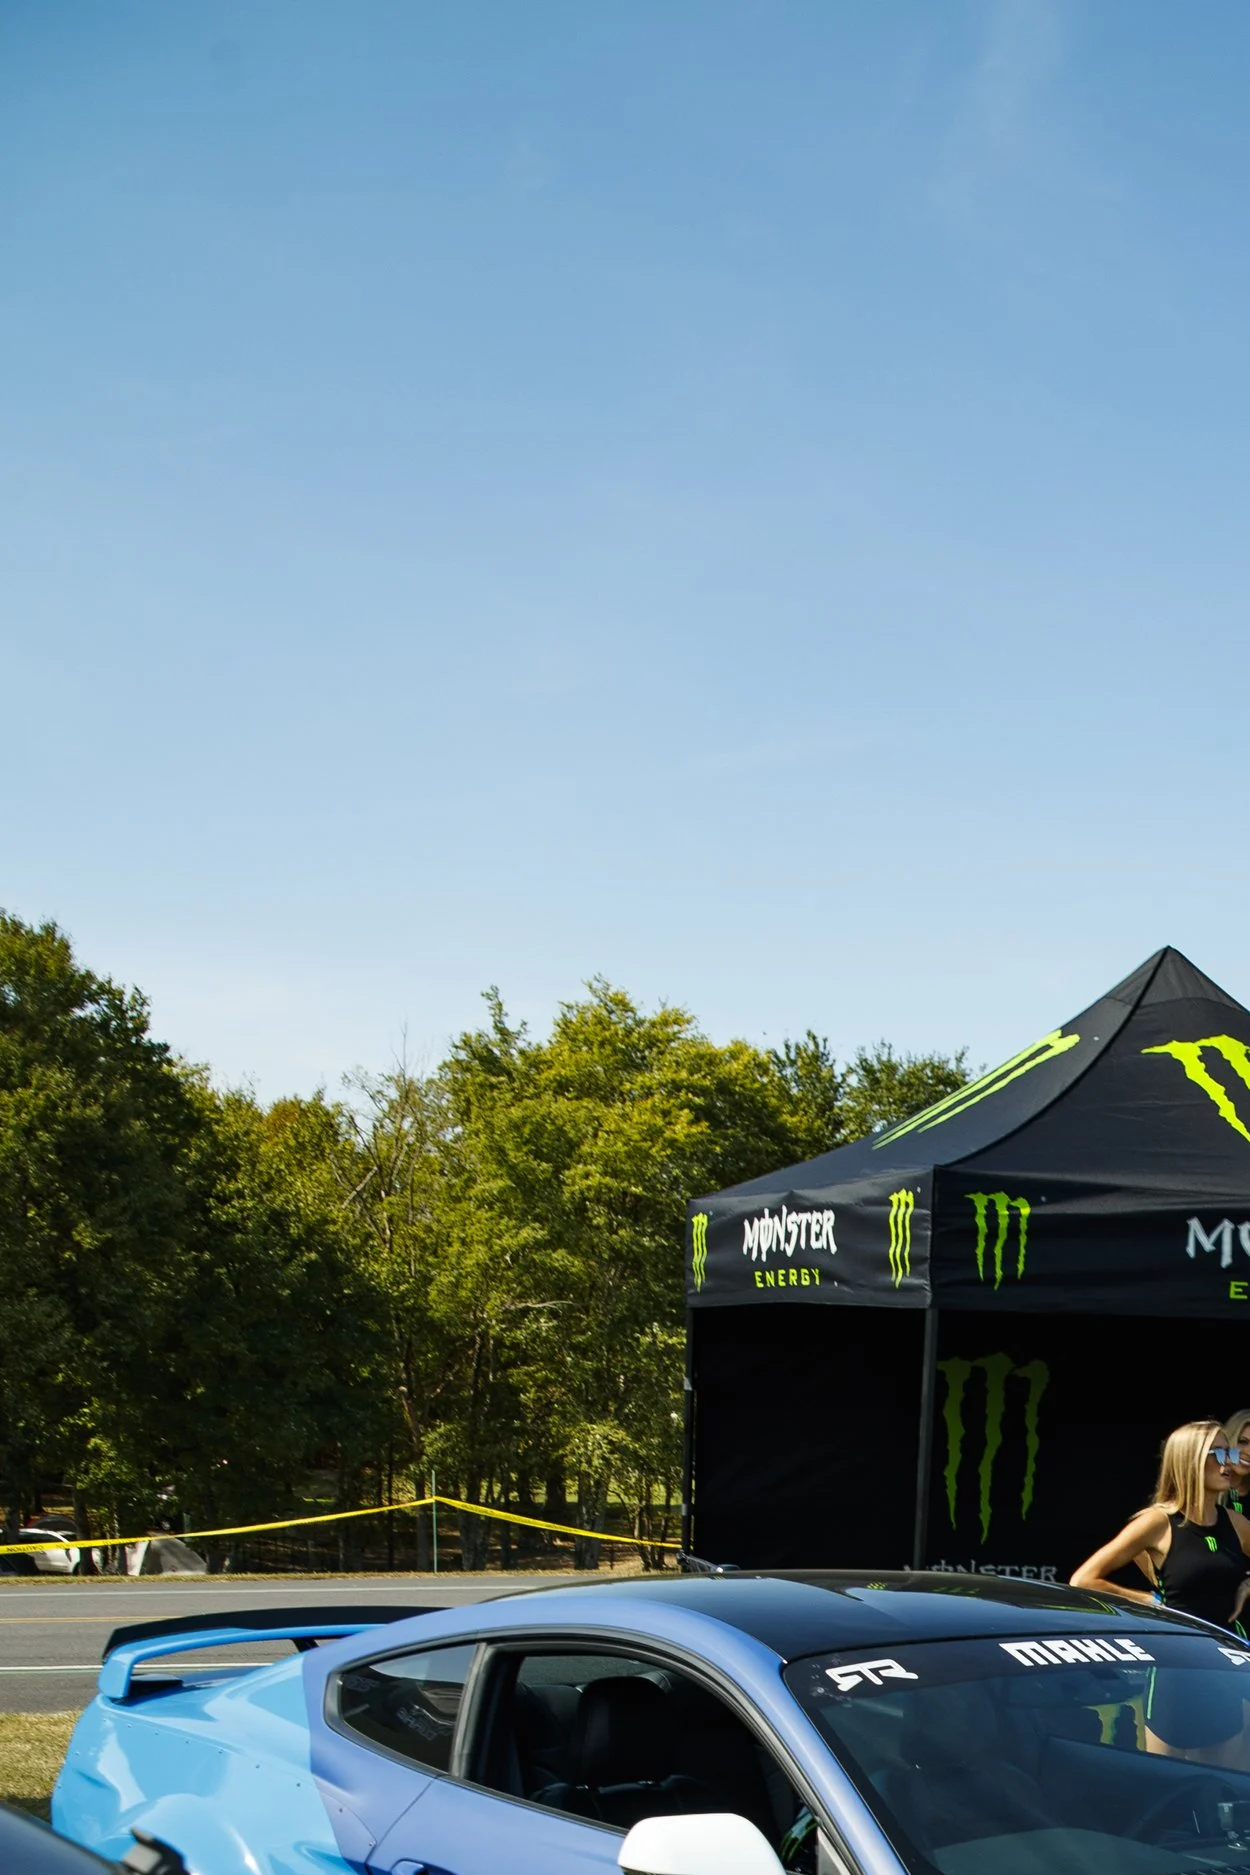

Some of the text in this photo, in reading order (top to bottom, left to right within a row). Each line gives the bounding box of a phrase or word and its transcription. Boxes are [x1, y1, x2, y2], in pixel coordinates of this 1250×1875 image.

[742, 1204, 838, 1262] MONSTER
[754, 1268, 822, 1288] ENERGY
[1001, 1638, 1156, 1667] MAHLE
